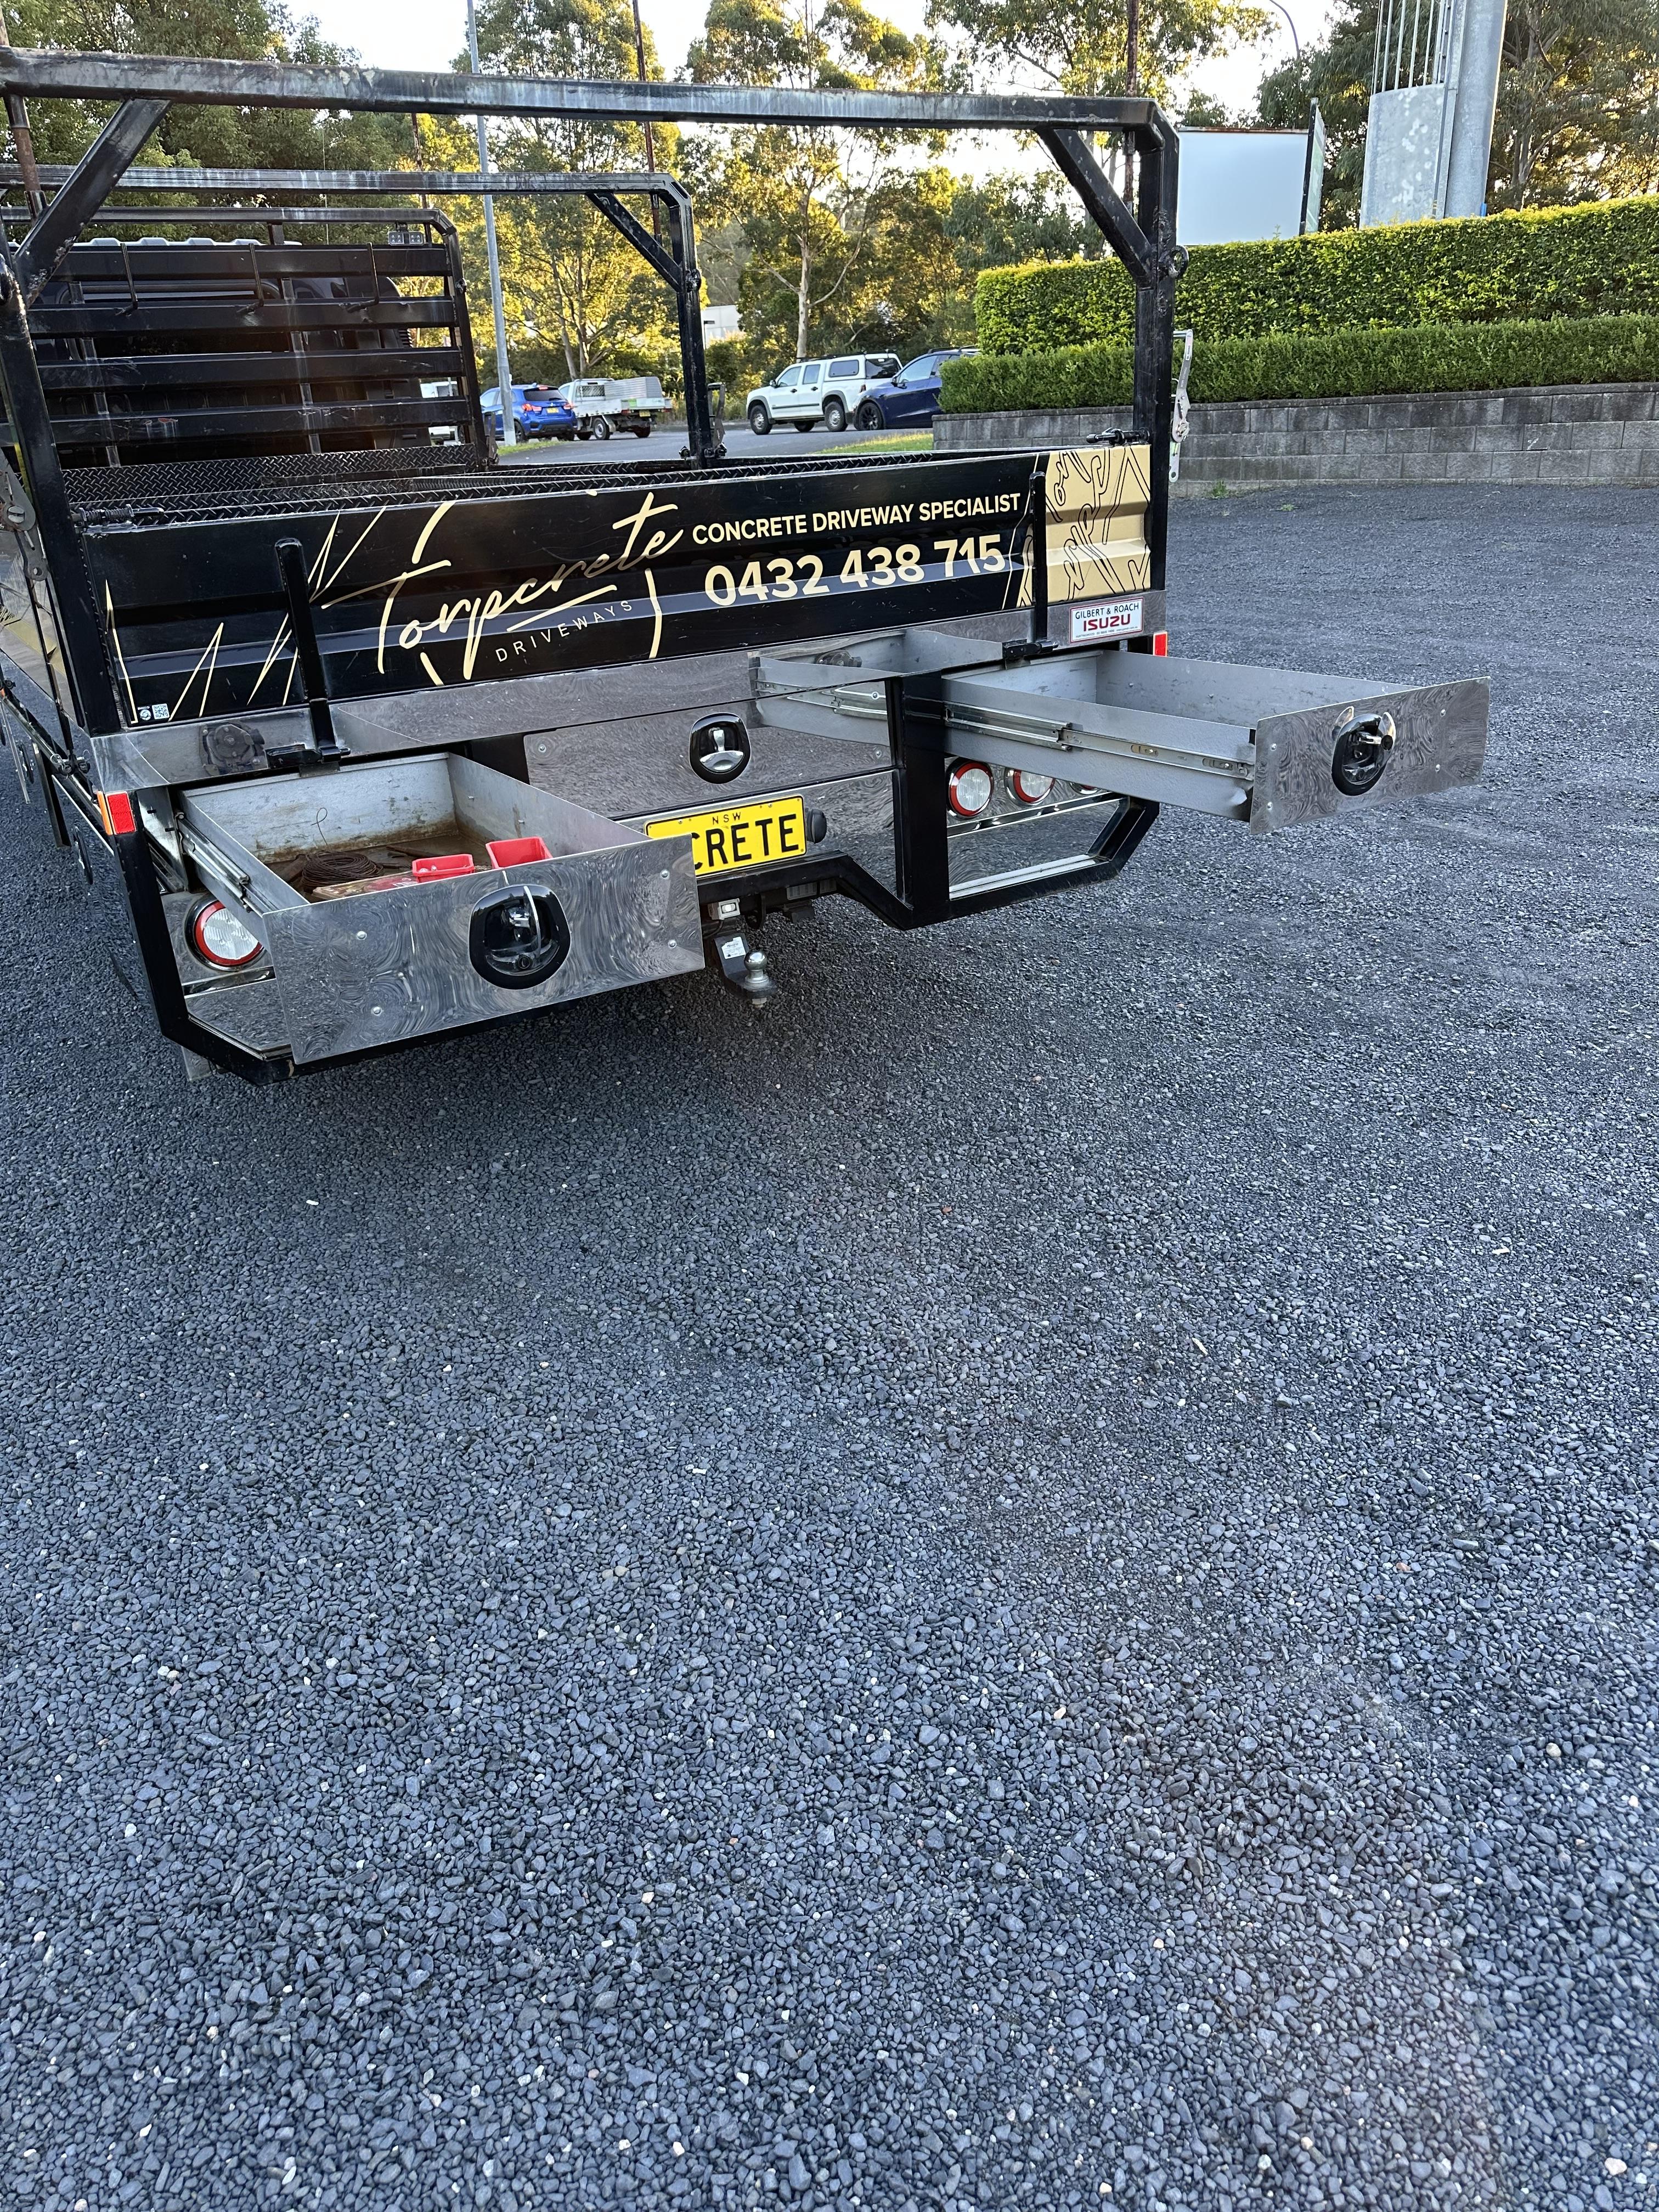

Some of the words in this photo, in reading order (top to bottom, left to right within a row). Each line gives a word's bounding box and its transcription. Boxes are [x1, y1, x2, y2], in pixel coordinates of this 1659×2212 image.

[692, 515, 807, 544] CONCRETE
[812, 504, 914, 532] DRIVEWAY
[919, 493, 1020, 521] SPECIALIST
[321, 492, 684, 680] Torpcrete
[705, 555, 830, 606] 0432
[840, 544, 924, 588] 438
[934, 534, 1006, 578] 715
[495, 600, 633, 663] DRIVEWAYS
[1075, 607, 1105, 619] GILBERT
[1114, 602, 1139, 613] ROACH
[1083, 613, 1131, 631] ISUZU
[712, 812, 741, 824] NSW
